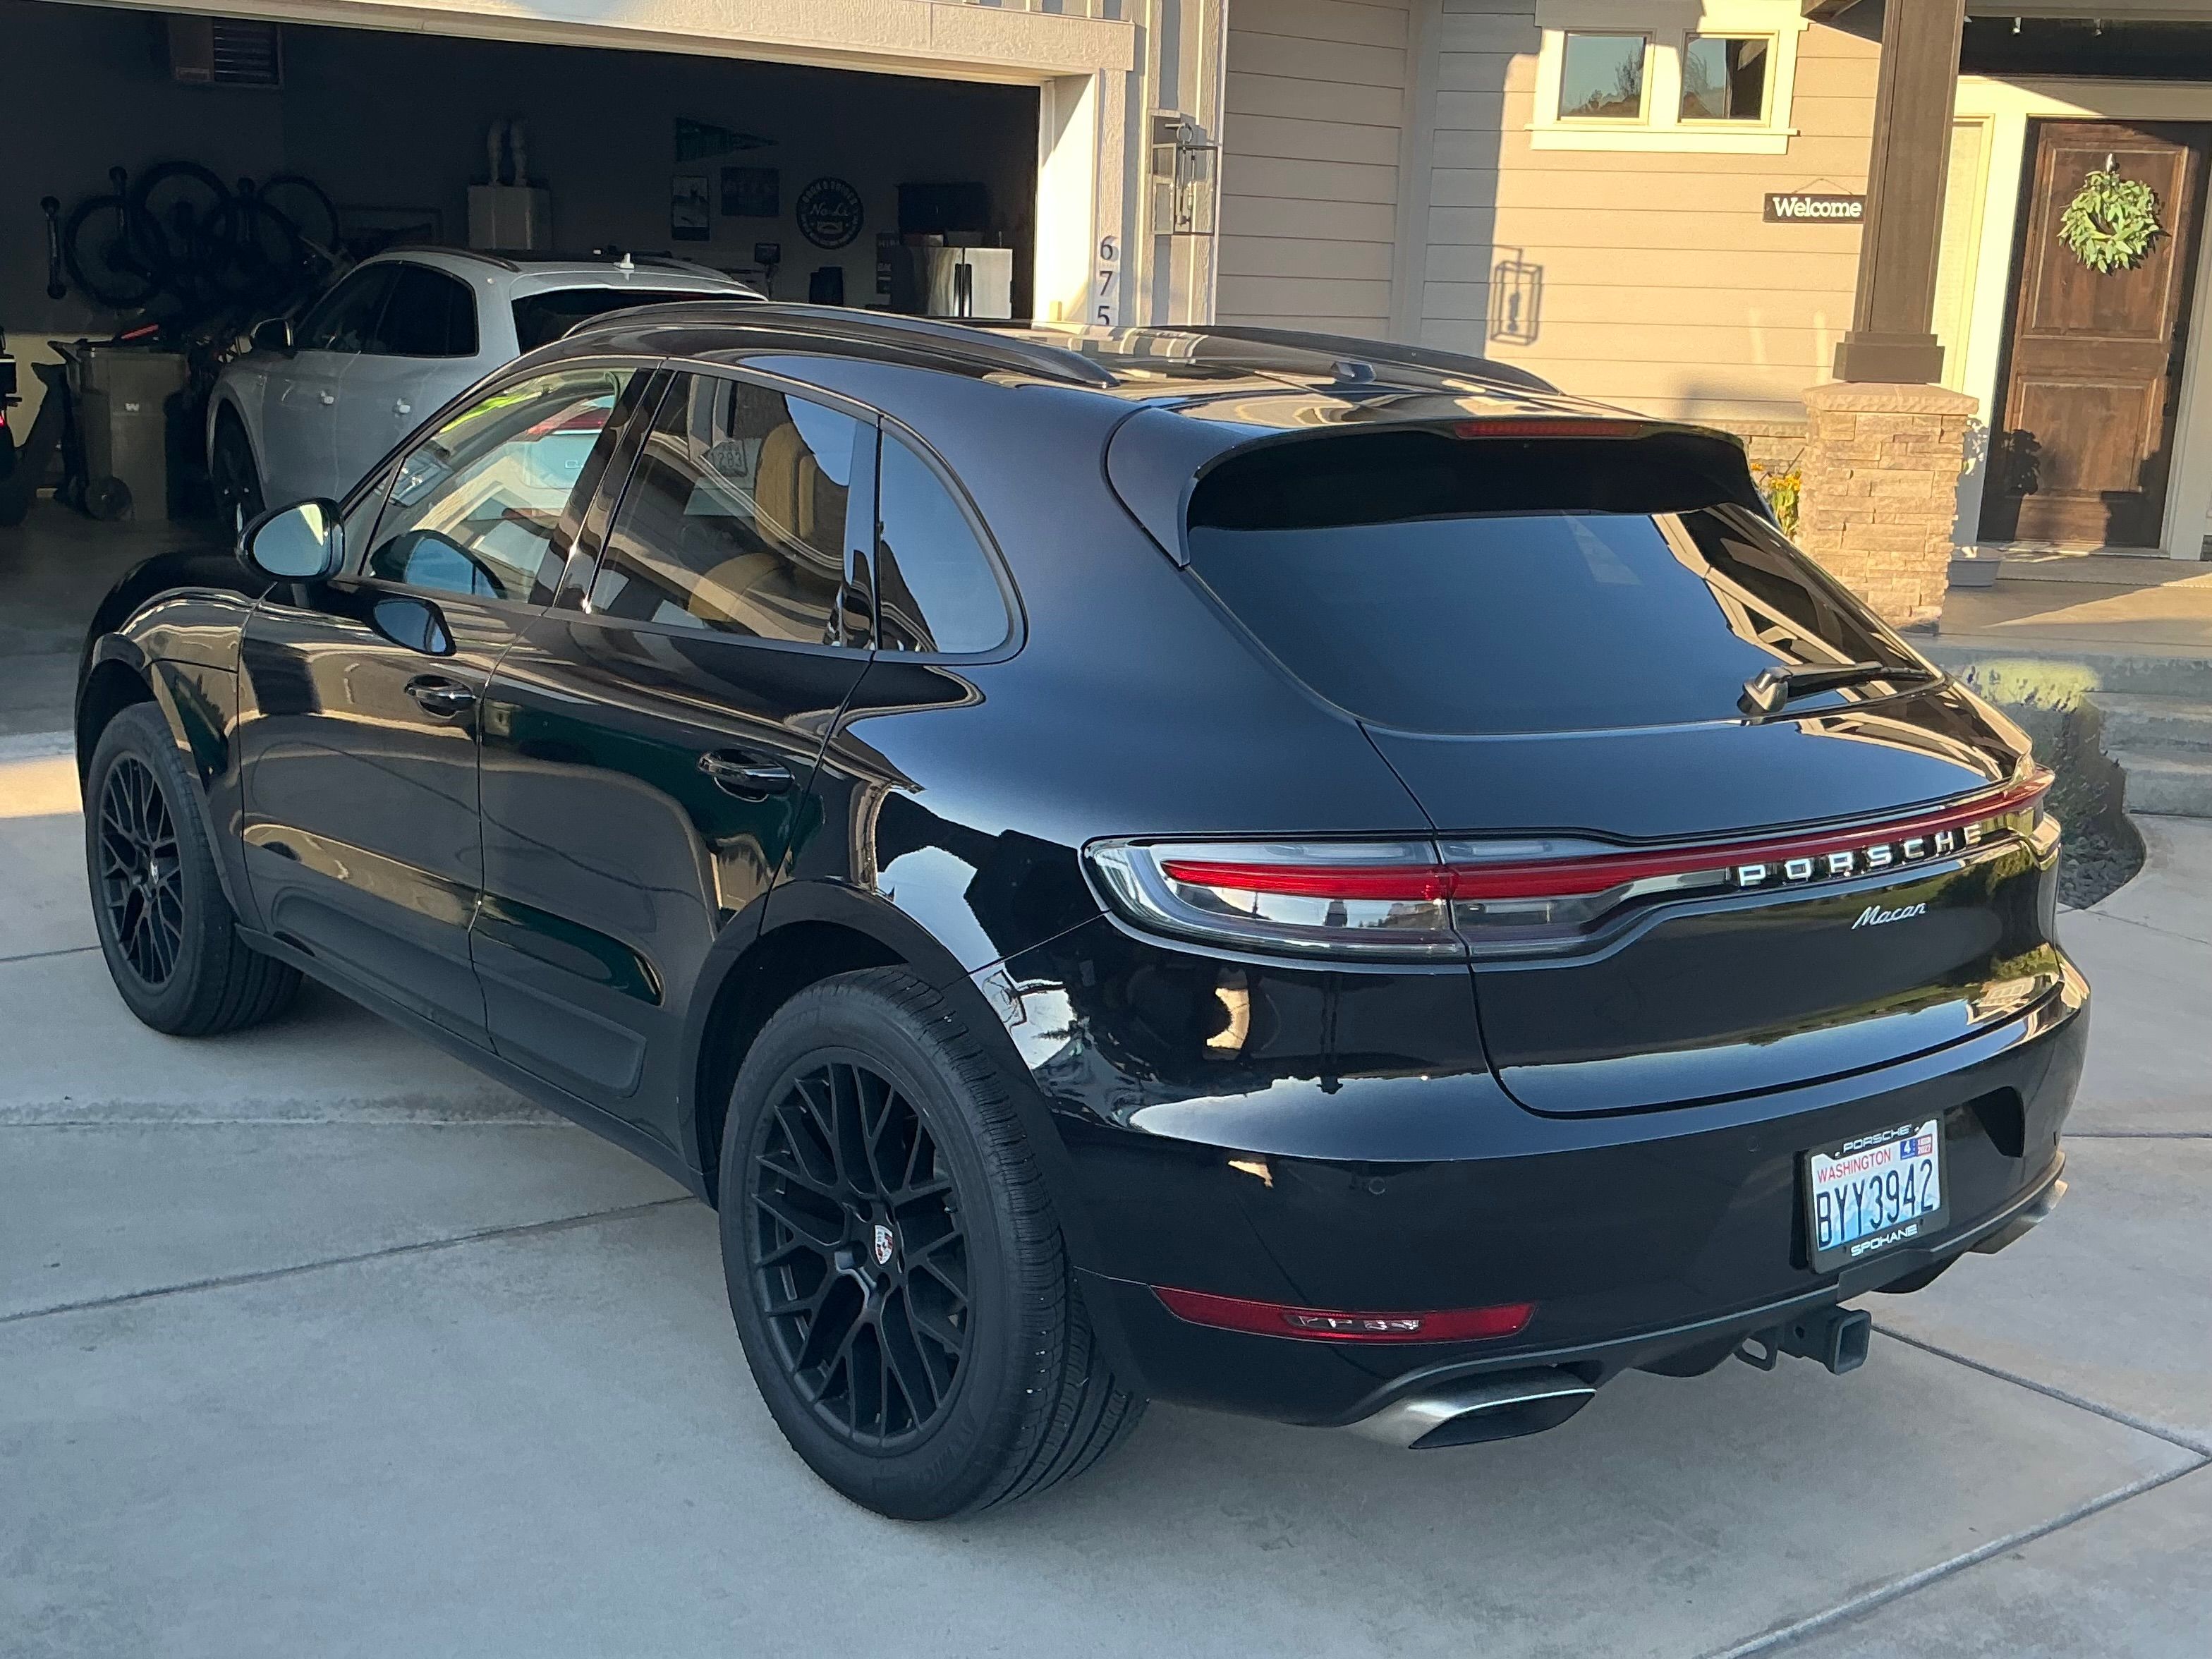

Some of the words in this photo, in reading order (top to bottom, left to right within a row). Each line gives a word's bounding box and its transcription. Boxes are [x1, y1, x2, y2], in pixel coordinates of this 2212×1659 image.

[1773, 198, 1862, 217] Welcome
[1098, 235, 1114, 326] 675
[1738, 824, 1982, 887] PORSCHE
[1852, 902, 1927, 930] Macan
[1843, 1125, 1911, 1153] PORSCHE
[1817, 1148, 1891, 1183] WASHINGTON
[1816, 1159, 1933, 1248] BYY3942
[1851, 1224, 1919, 1257] SPOKANE
